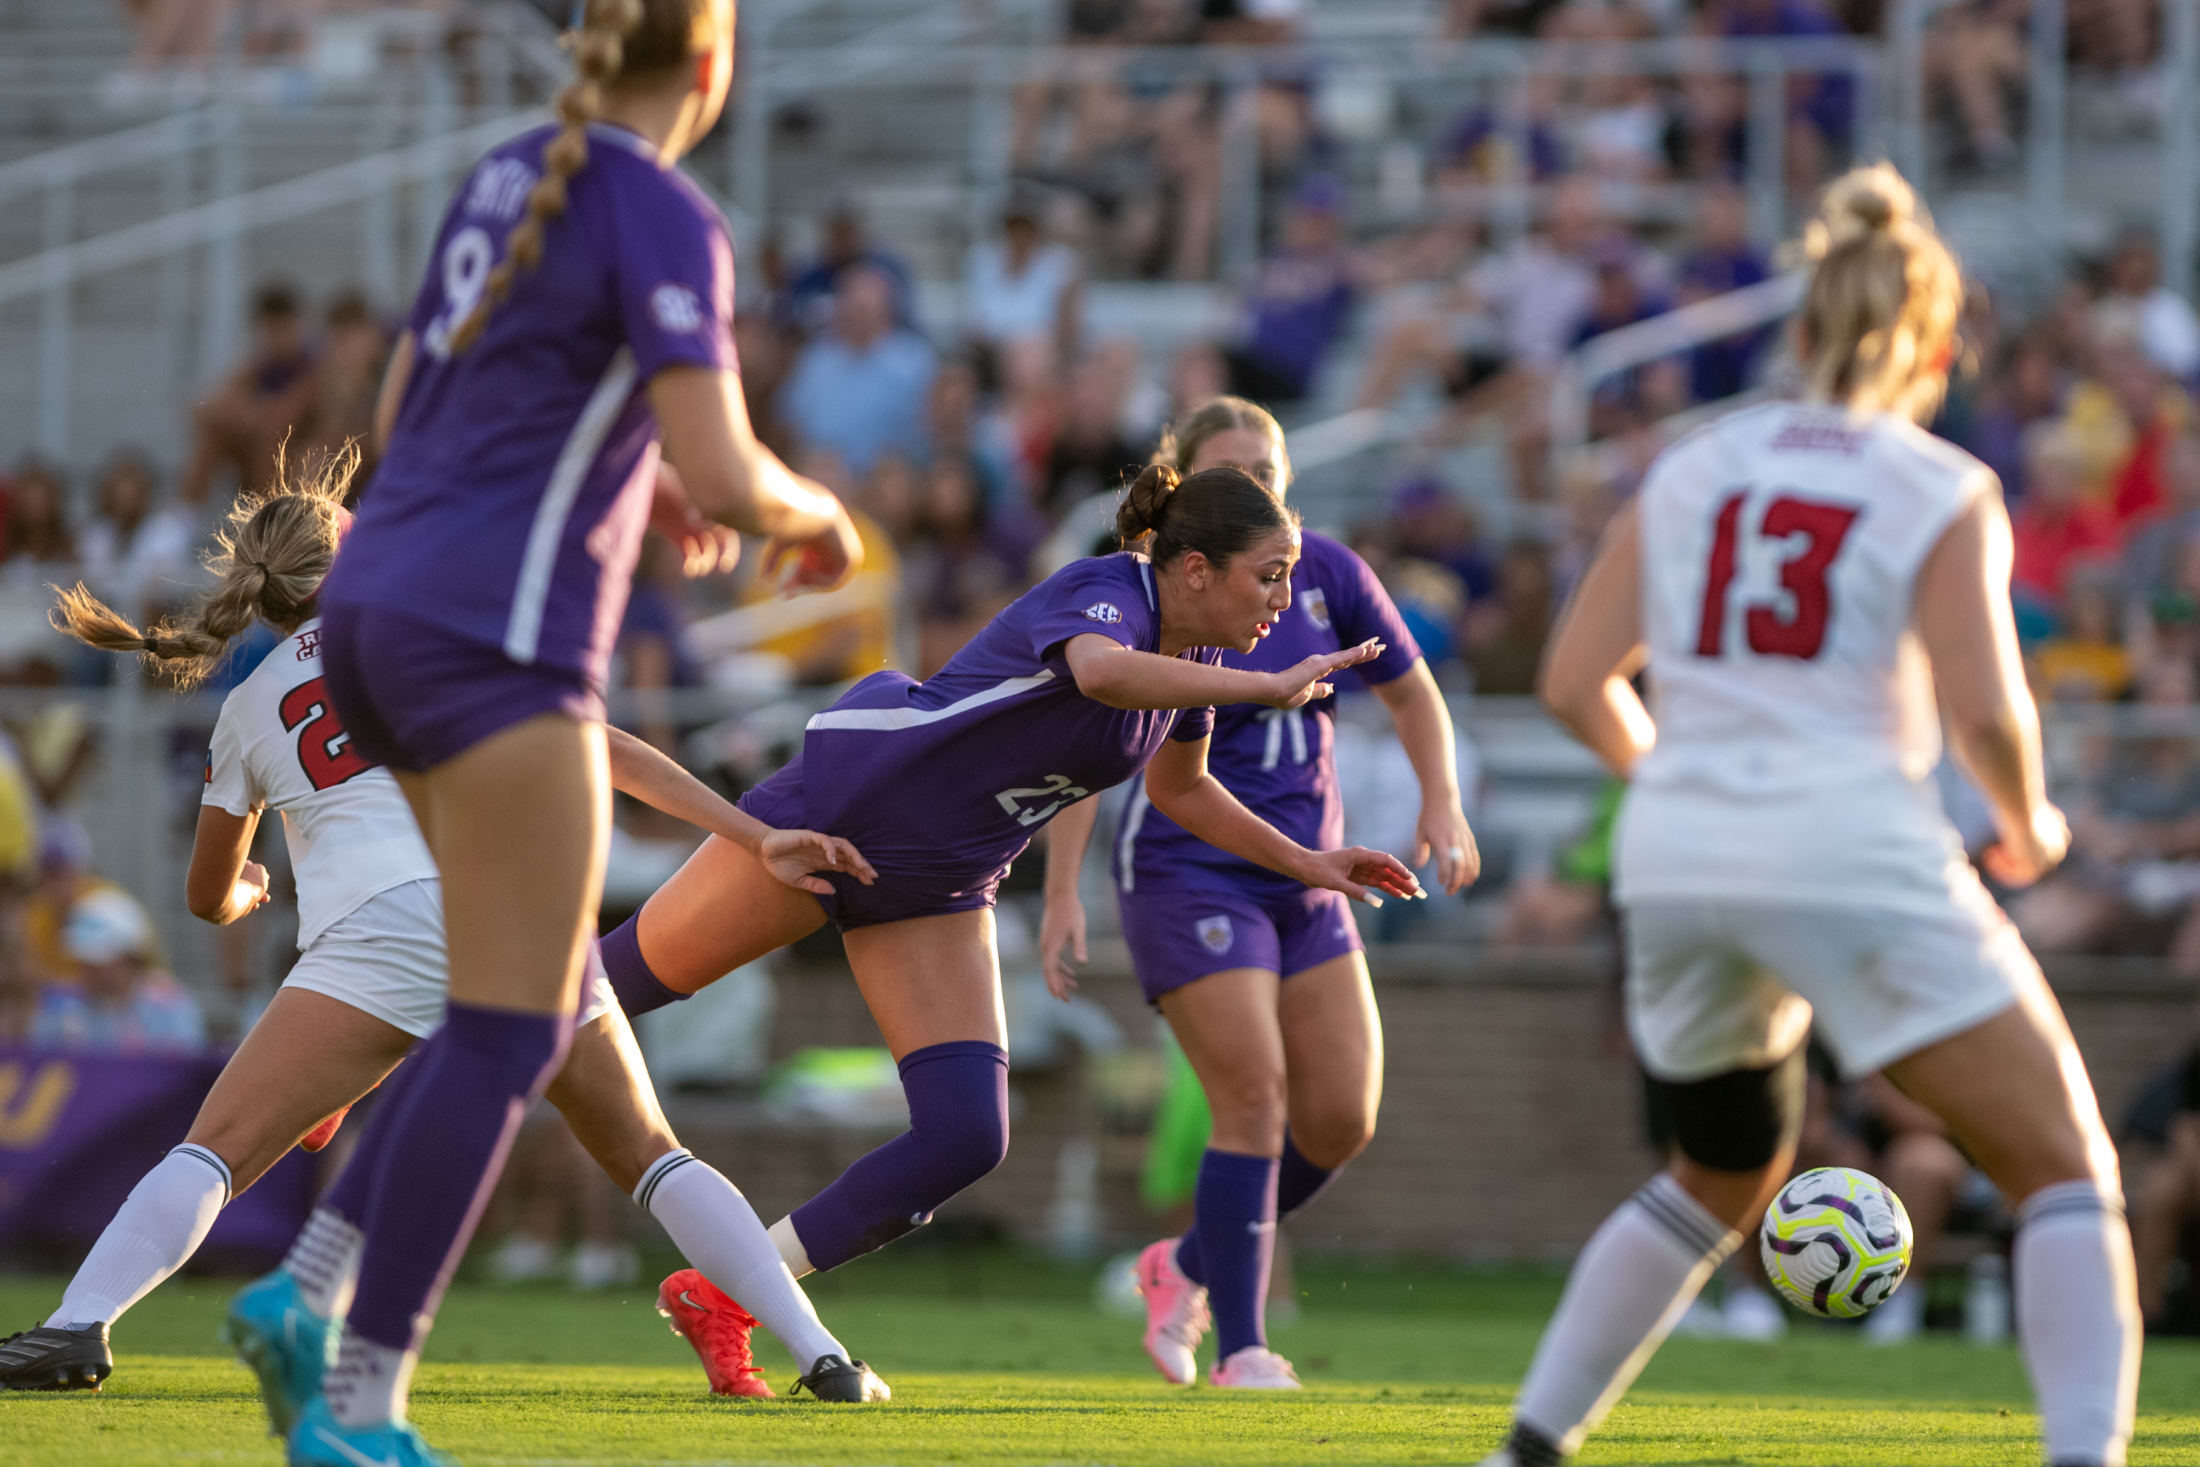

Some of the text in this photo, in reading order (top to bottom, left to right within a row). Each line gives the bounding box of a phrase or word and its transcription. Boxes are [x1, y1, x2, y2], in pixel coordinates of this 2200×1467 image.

[424, 225, 493, 362] 9
[1086, 603, 1119, 622] SEC
[1696, 490, 1870, 660] 13
[994, 774, 1089, 827] 23
